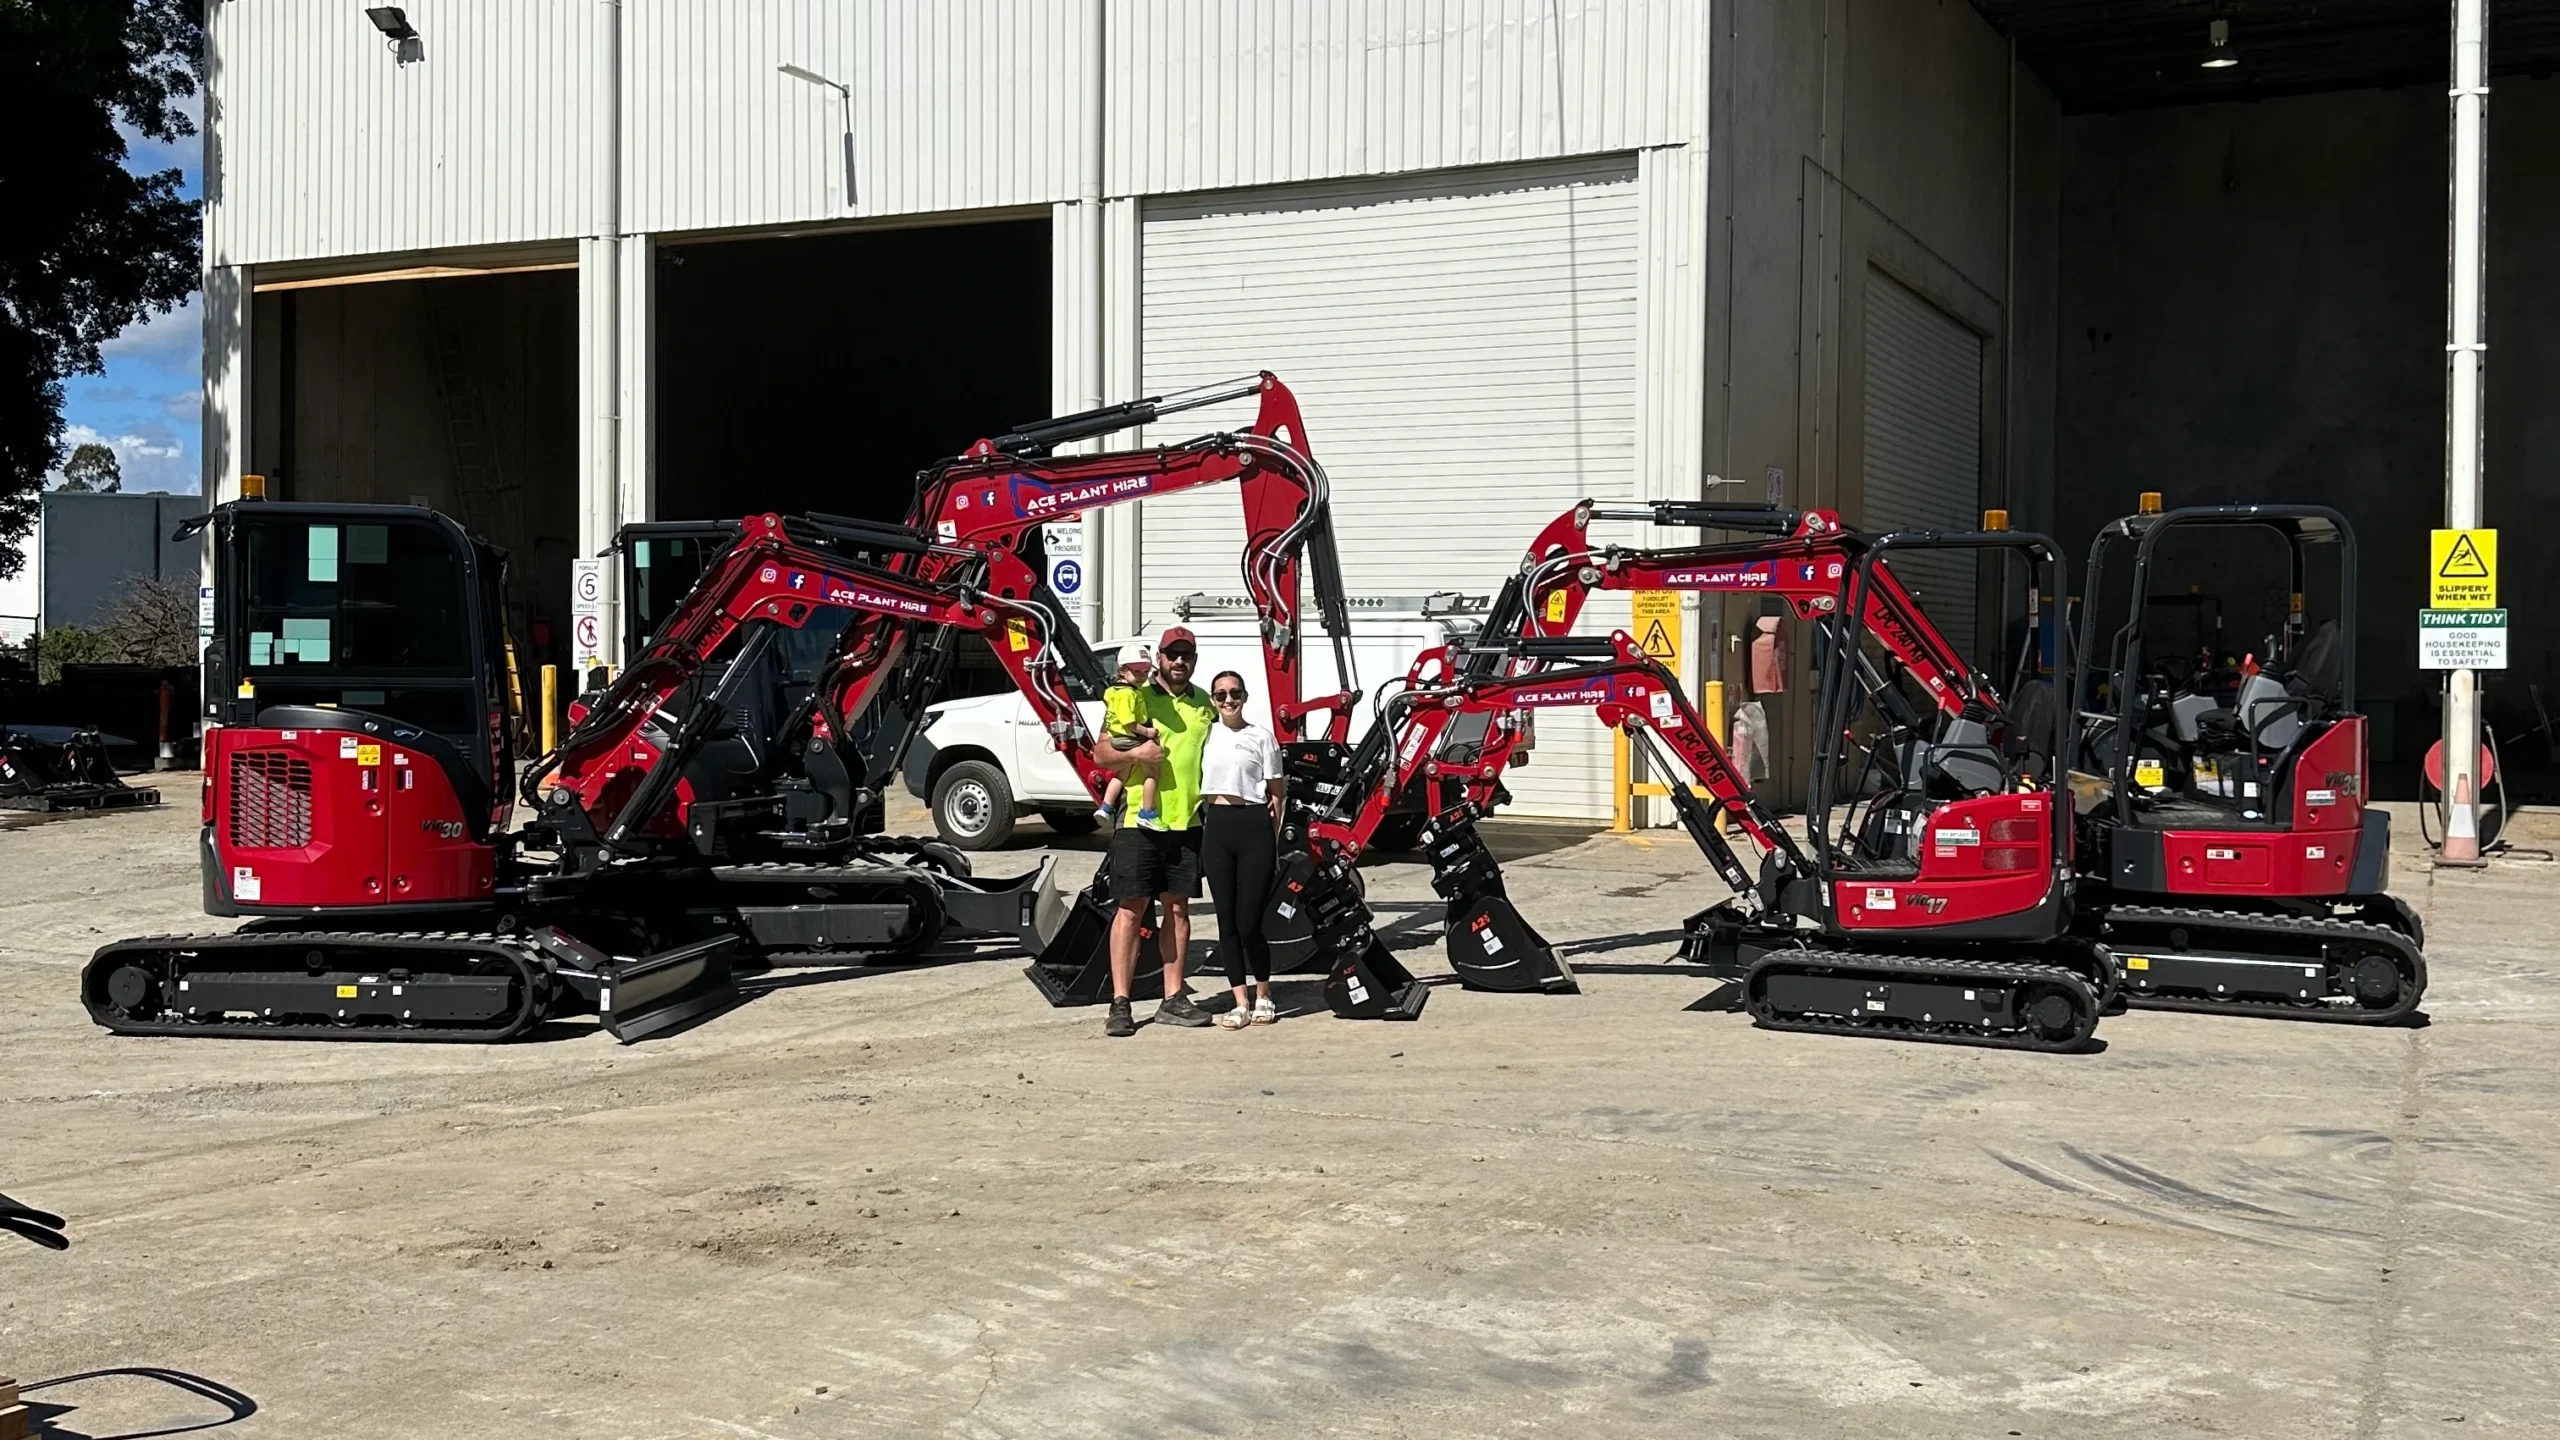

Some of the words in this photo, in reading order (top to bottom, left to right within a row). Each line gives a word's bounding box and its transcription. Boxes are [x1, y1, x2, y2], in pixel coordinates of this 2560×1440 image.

[1027, 494, 1056, 511] ACE
[1060, 484, 1108, 504] PLANT
[1113, 476, 1148, 493] HIRE
[1667, 574, 1693, 583] ACE
[1695, 573, 1736, 582] PLANT
[1739, 572, 1768, 582] HIRE
[585, 578, 595, 596] 5
[830, 589, 856, 600] ACE
[858, 593, 898, 607] PLANT
[900, 600, 928, 613] HIRE
[2435, 593, 2467, 601] WHEN
[2469, 593, 2492, 601] WET
[2422, 613, 2467, 625] THINK
[2469, 613, 2504, 625] TIDY
[1516, 693, 1539, 703] ACE
[1541, 692, 1577, 701] PLANT
[1580, 690, 1605, 699] HIRE
[1674, 726, 1702, 751] LPC
[1694, 750, 1714, 766] 40
